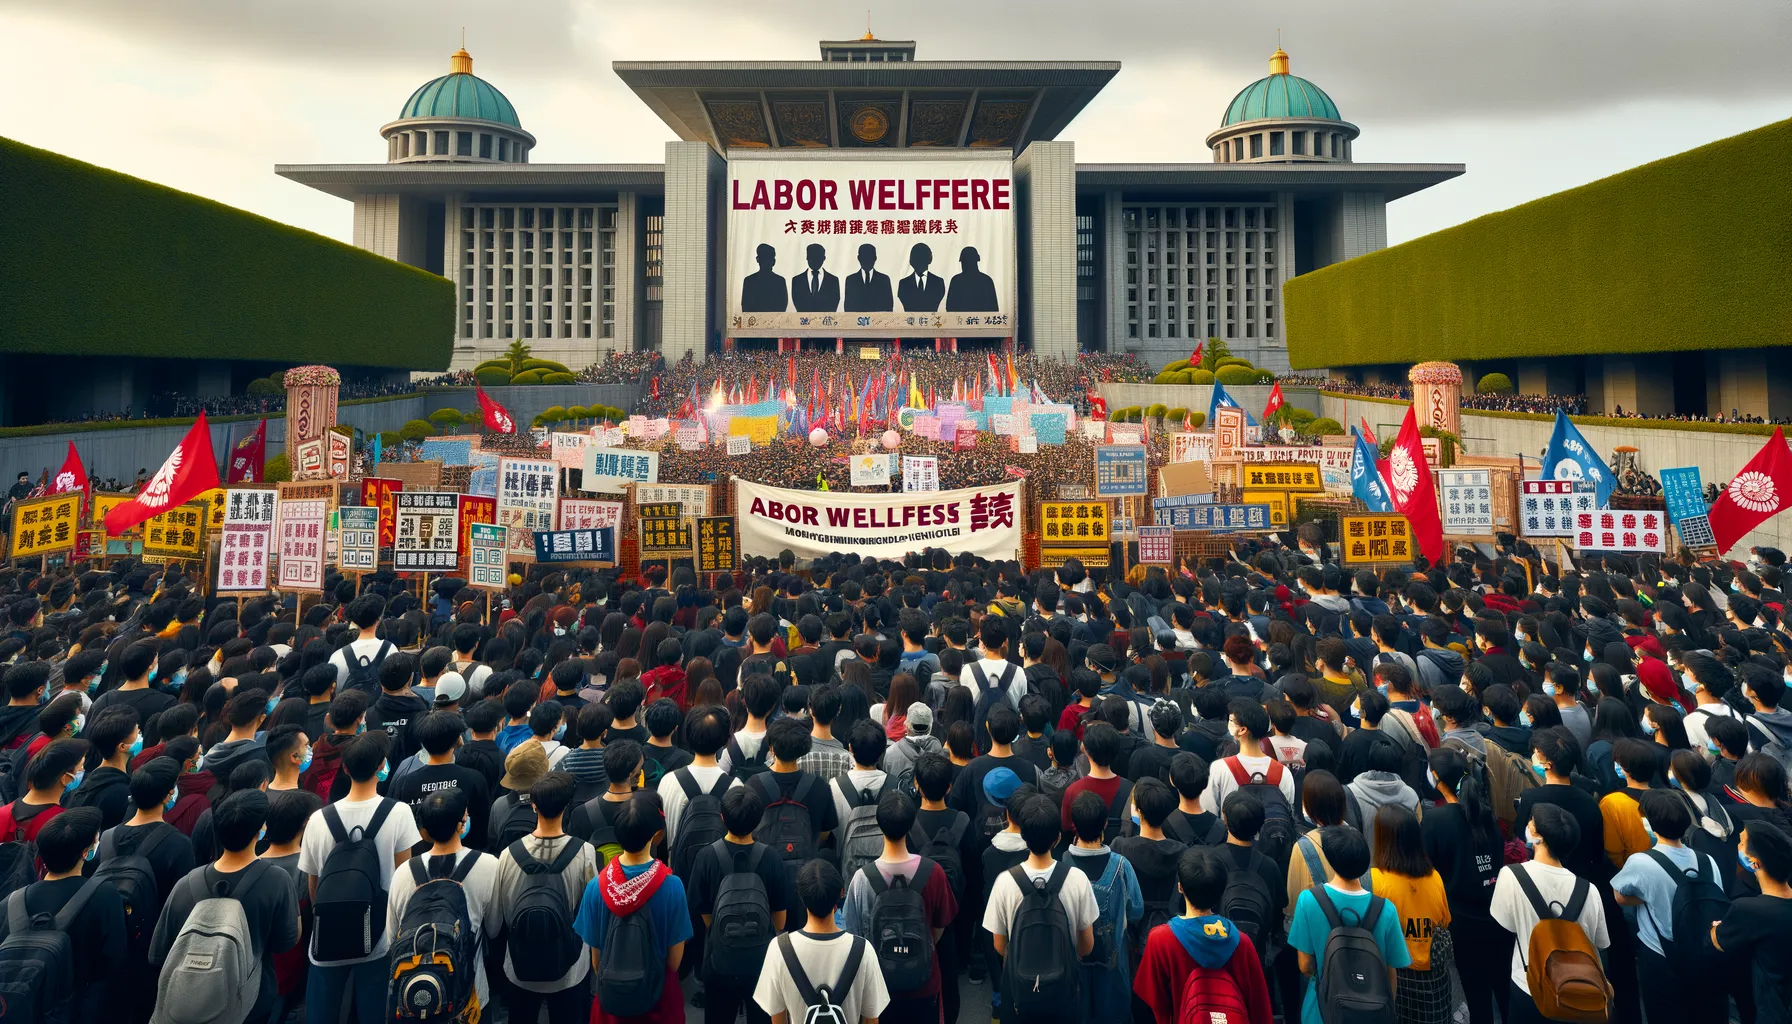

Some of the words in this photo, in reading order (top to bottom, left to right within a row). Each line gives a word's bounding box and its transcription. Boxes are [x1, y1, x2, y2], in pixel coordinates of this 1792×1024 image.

[732, 178, 838, 211] LABOR
[848, 178, 1010, 211] WELFFERE
[749, 497, 819, 527] ABOR
[826, 501, 960, 529] WELLFESS
